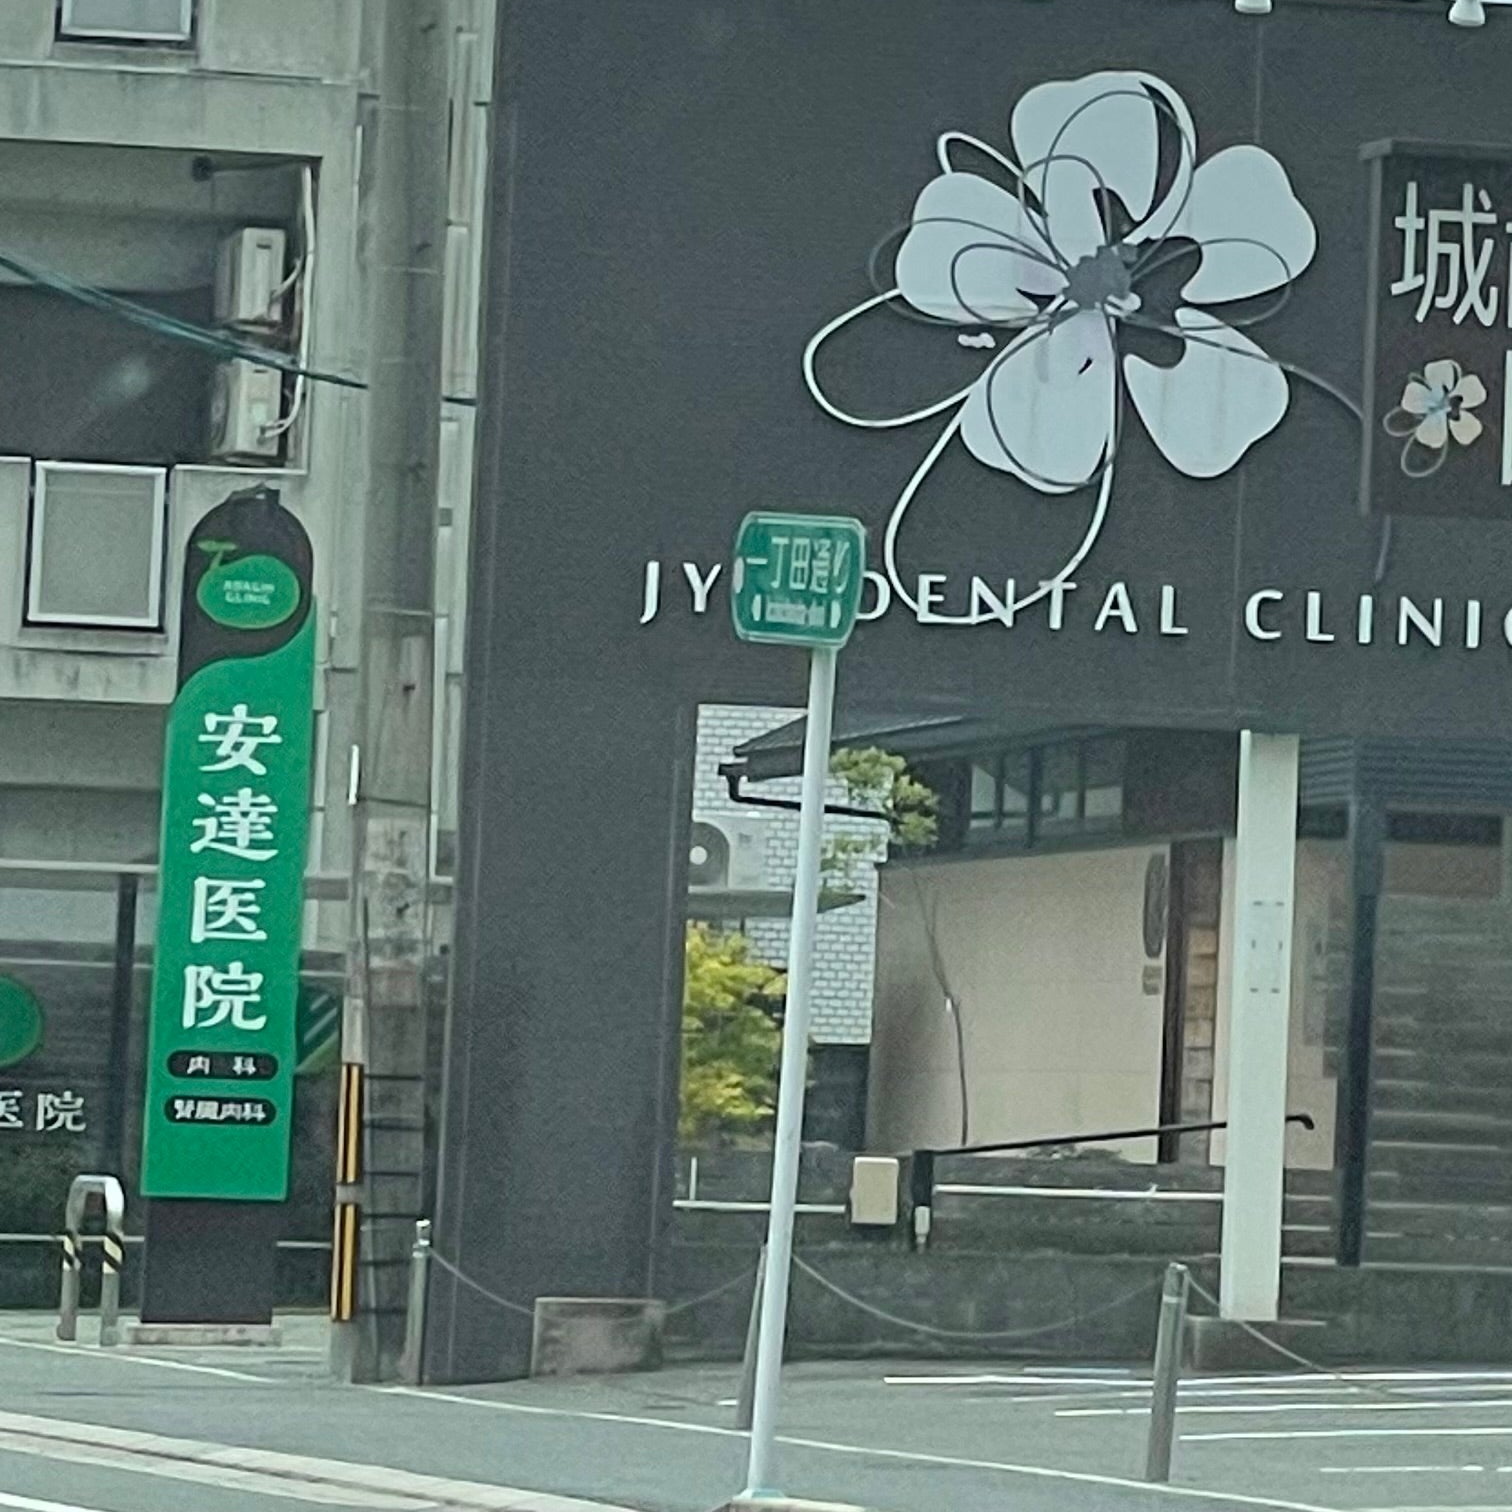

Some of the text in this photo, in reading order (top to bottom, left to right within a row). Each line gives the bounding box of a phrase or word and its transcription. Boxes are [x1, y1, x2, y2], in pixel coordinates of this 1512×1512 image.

[857, 570, 1189, 635] DENTAL
[182, 703, 282, 1030] 安達医院
